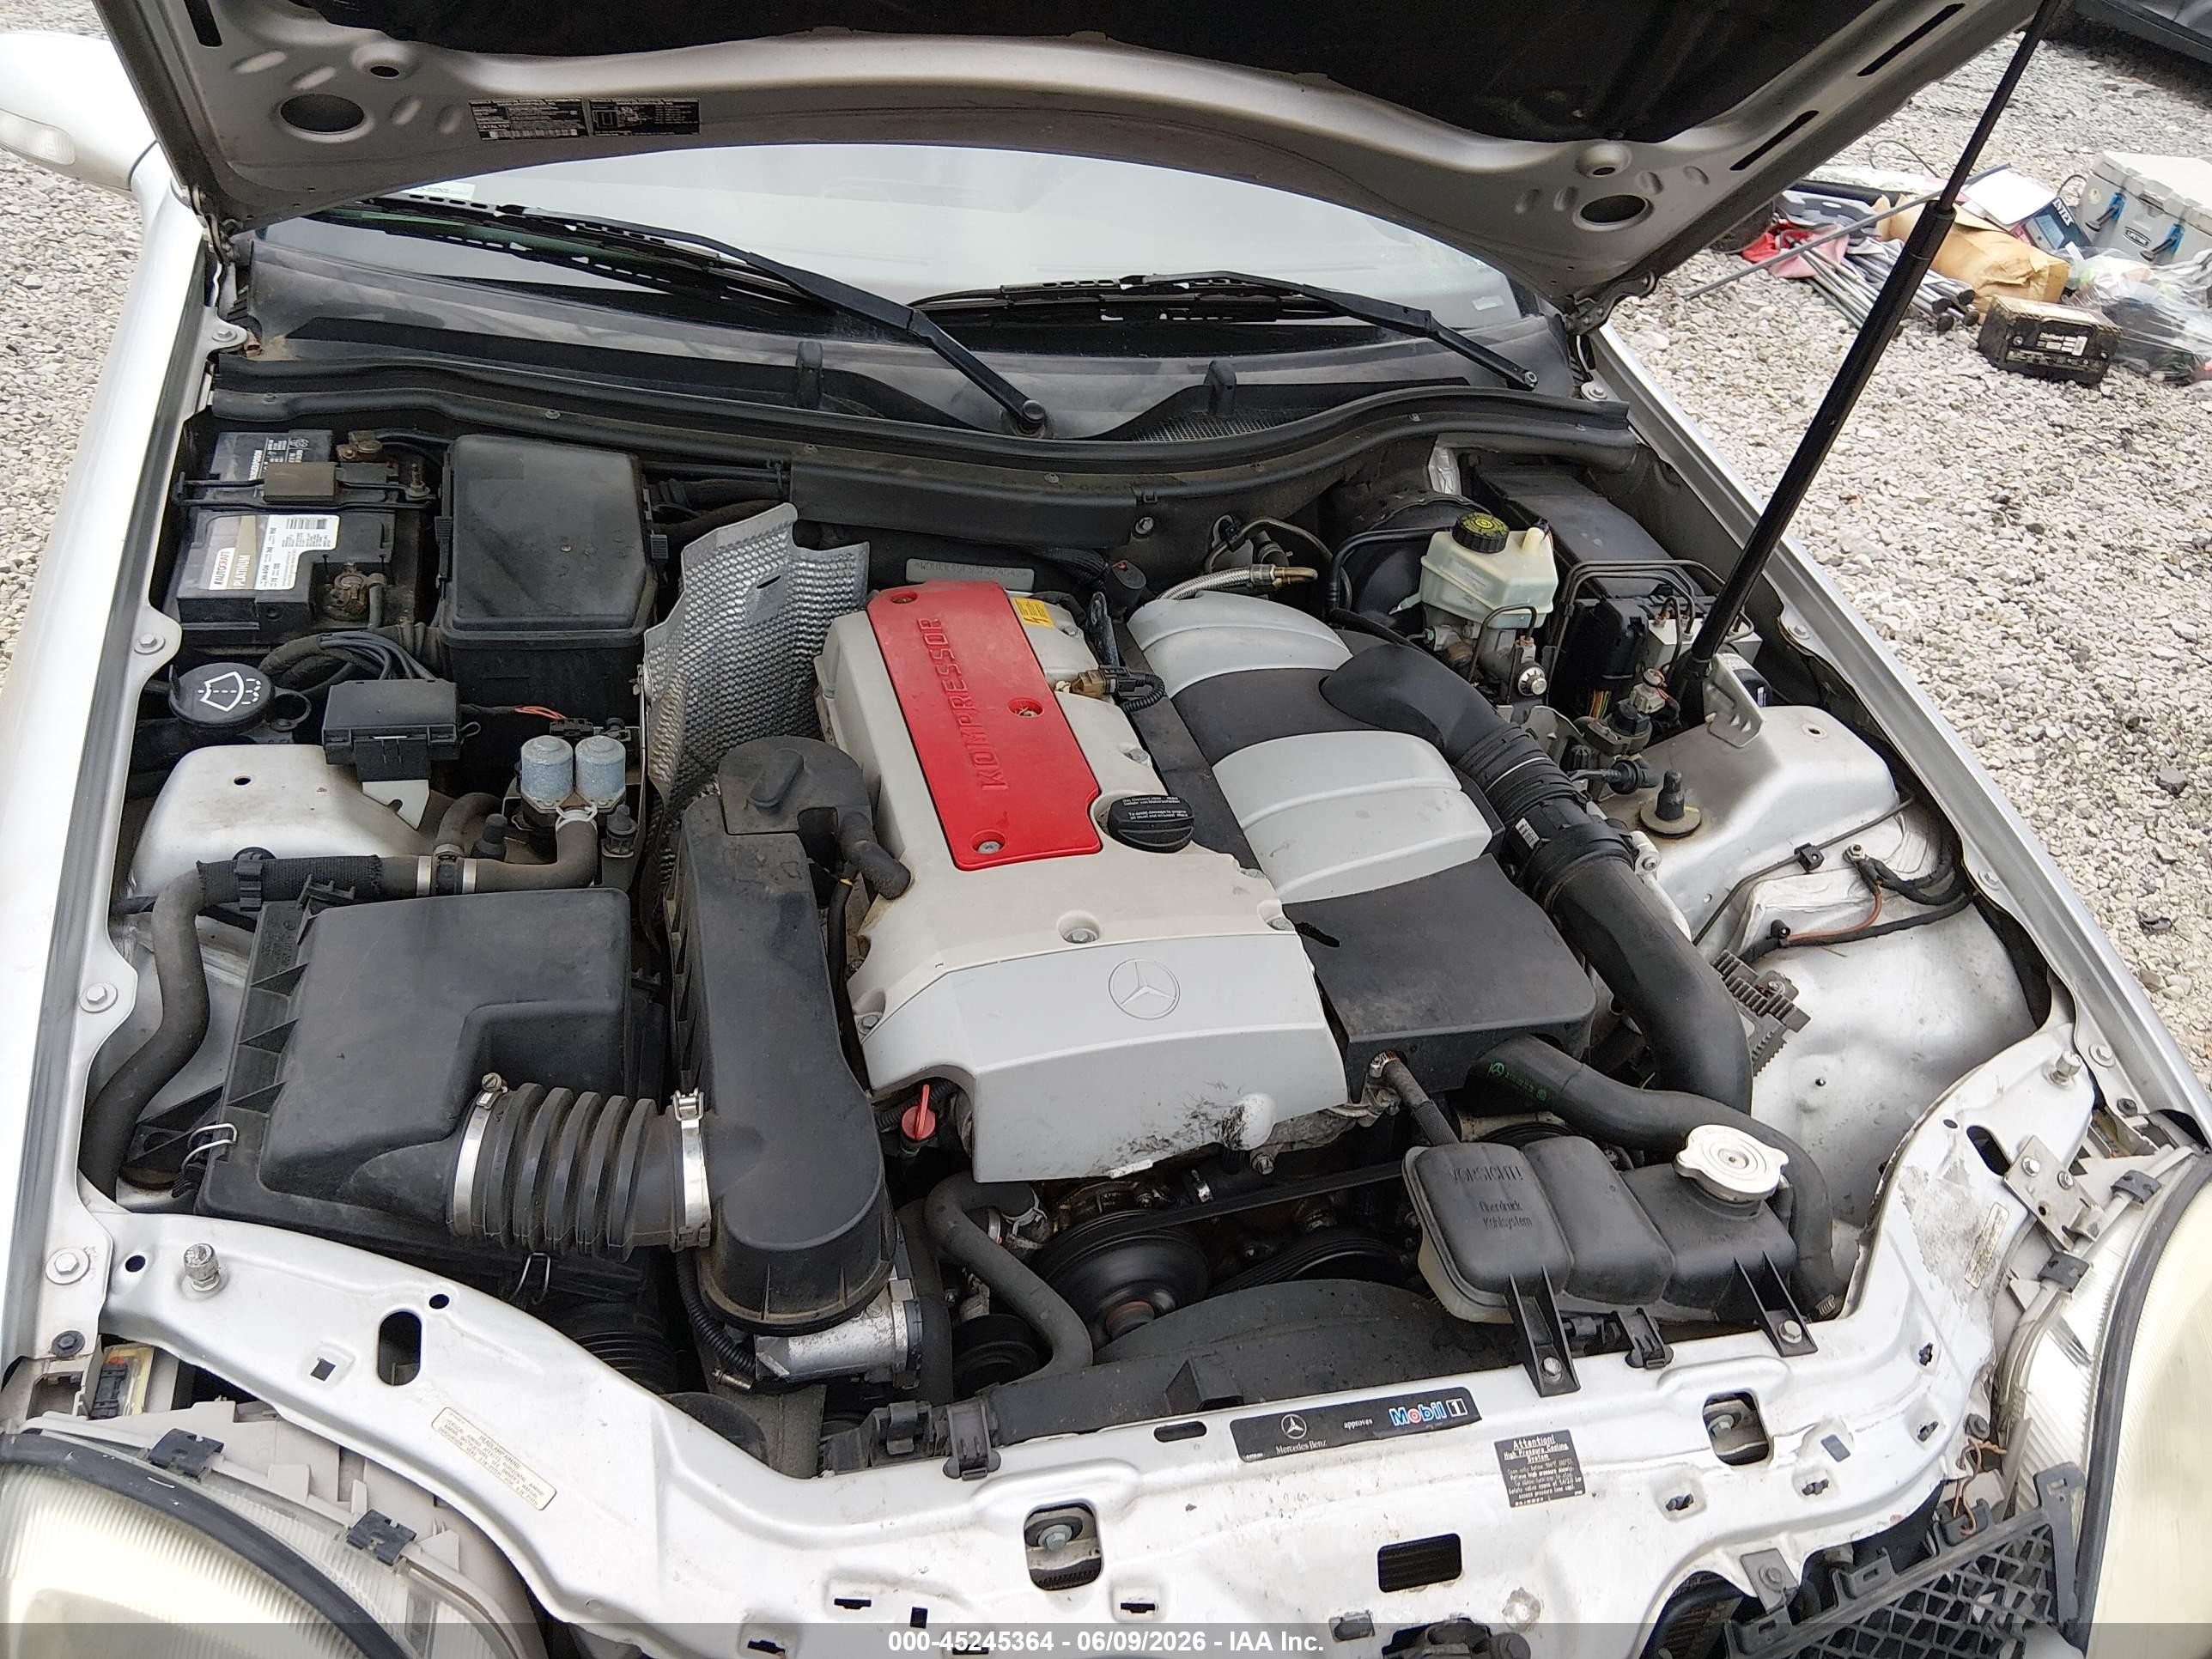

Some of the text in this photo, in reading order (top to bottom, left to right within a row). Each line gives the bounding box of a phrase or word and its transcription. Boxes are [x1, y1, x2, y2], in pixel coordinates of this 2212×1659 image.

[2052, 198, 2075, 226] INTEX
[233, 553, 251, 587] PLATINUM
[917, 617, 1008, 790] KOMPRESSOR
[1449, 1165, 1523, 1182] VORSICHT!
[1343, 1419, 1373, 1430] approves
[1389, 1401, 1447, 1427] Mobil
[1275, 1438, 1328, 1454] Mercedes Benz
[1513, 1434, 1556, 1450] Attention!
[1504, 1443, 1569, 1460] High Pressure Cooling
[1527, 1454, 1551, 1464] System
